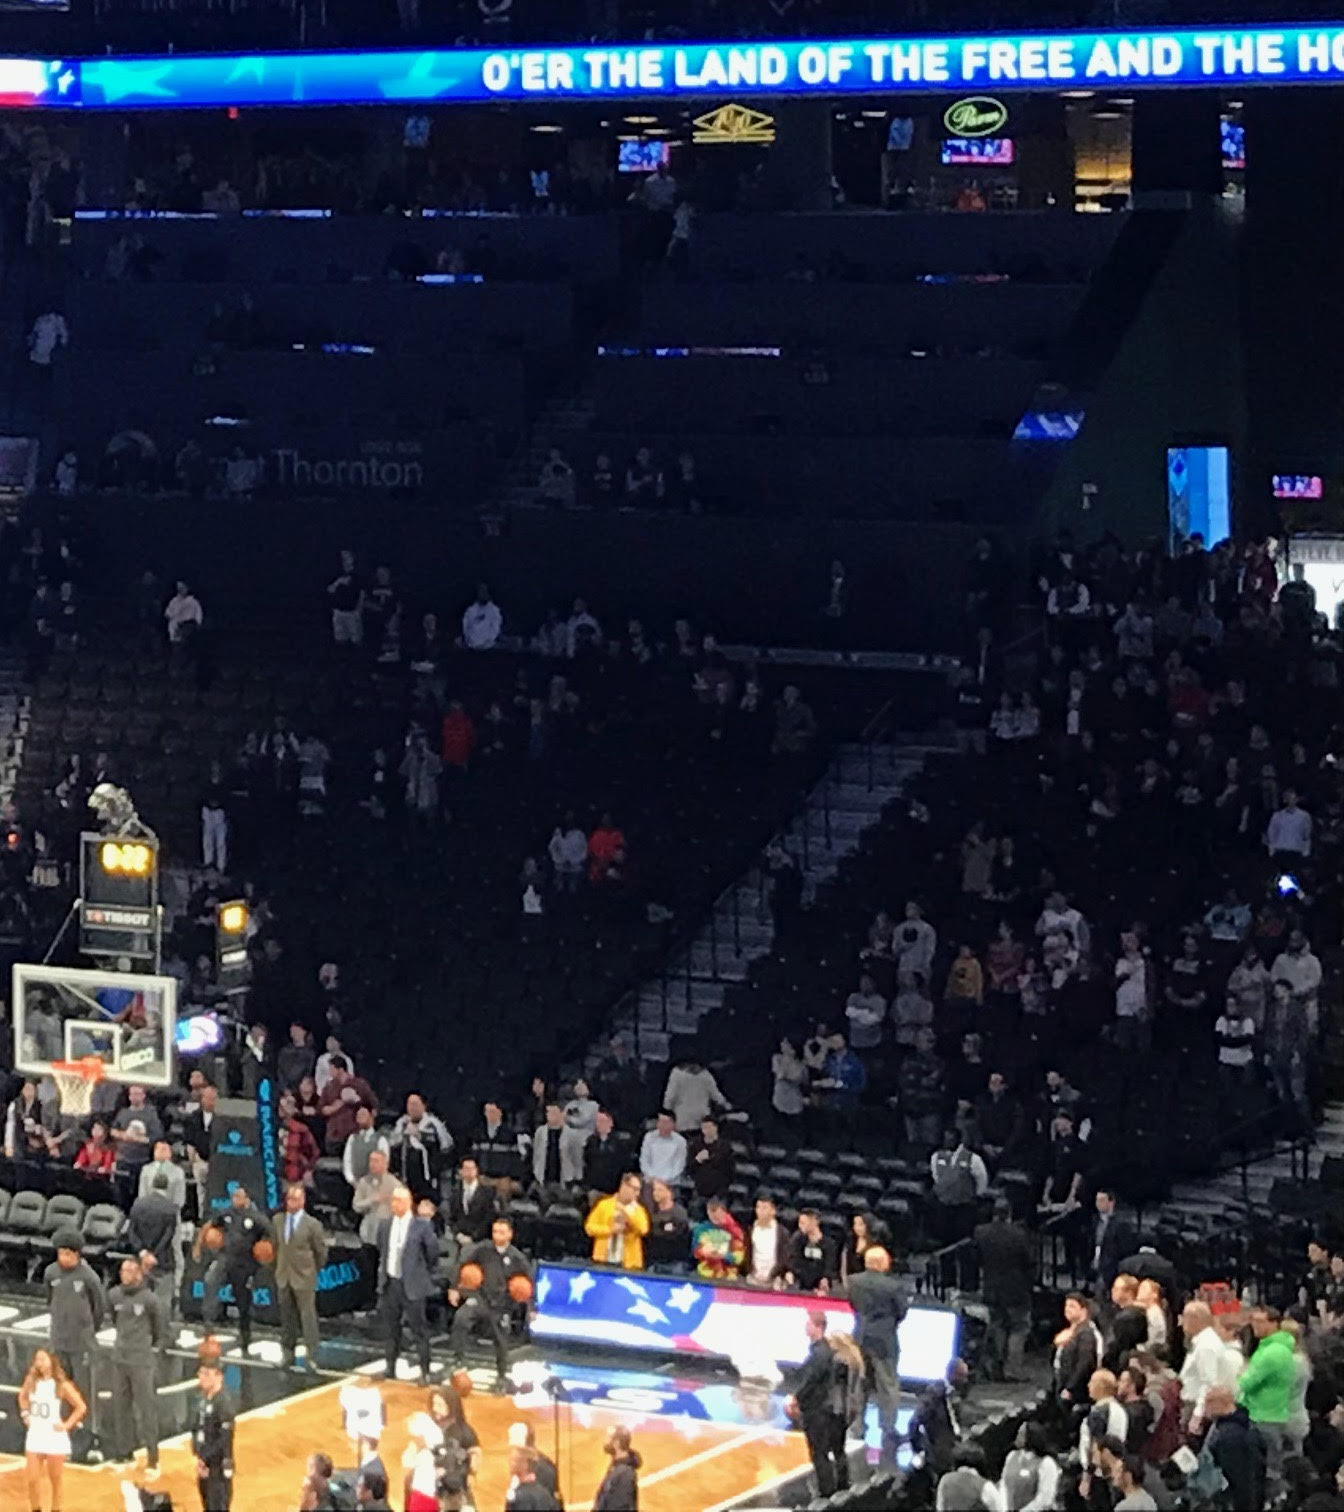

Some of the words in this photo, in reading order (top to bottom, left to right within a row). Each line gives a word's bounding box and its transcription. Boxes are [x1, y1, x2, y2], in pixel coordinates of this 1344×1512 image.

[481, 52, 574, 92] O'ER
[583, 49, 664, 89] THE
[674, 46, 788, 87] LAND
[797, 45, 854, 84] OF
[863, 42, 950, 82] THE
[960, 39, 1076, 80] FREE
[1084, 37, 1183, 78] AND
[1193, 34, 1286, 75] THE
[269, 448, 423, 488] Thornton
